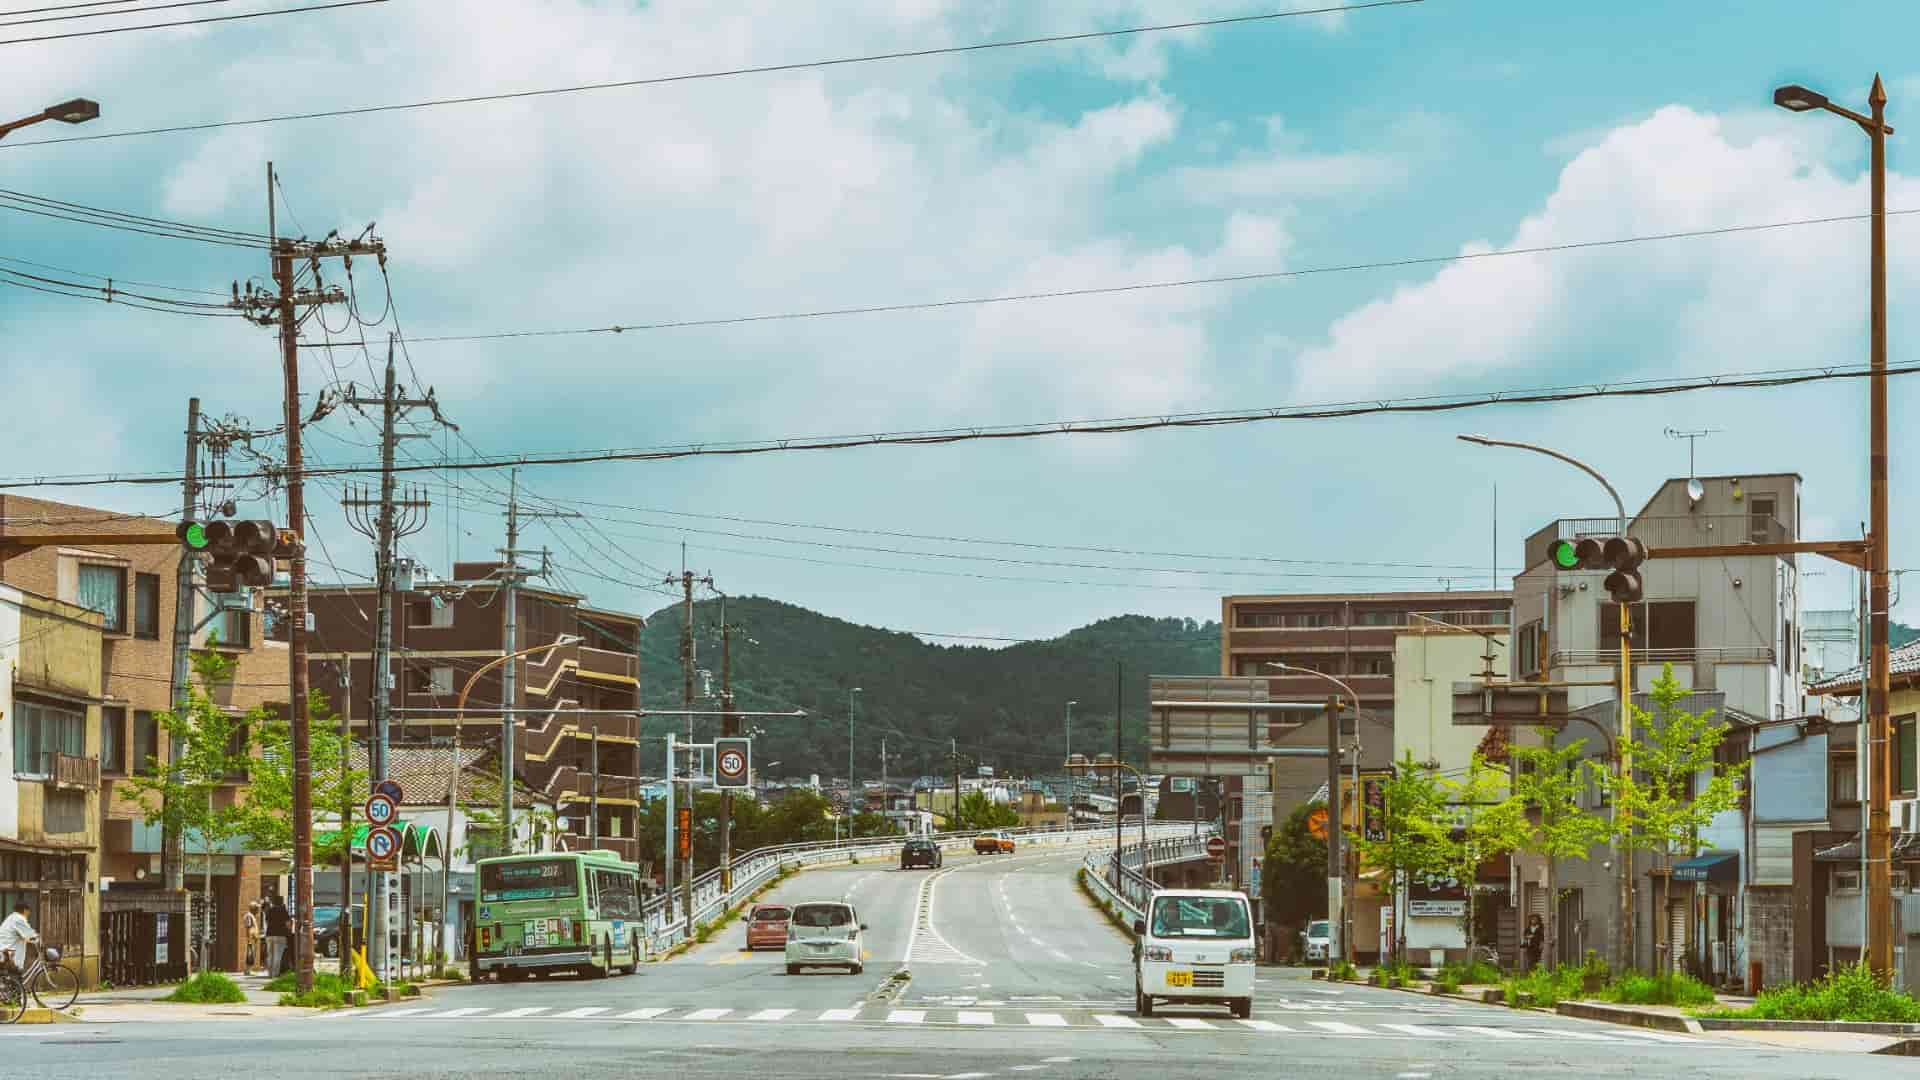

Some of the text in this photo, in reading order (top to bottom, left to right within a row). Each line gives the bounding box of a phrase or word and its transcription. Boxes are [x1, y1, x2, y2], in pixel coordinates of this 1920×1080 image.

[724, 757, 740, 770] 50
[372, 803, 388, 817] 50
[542, 865, 559, 877] 207
